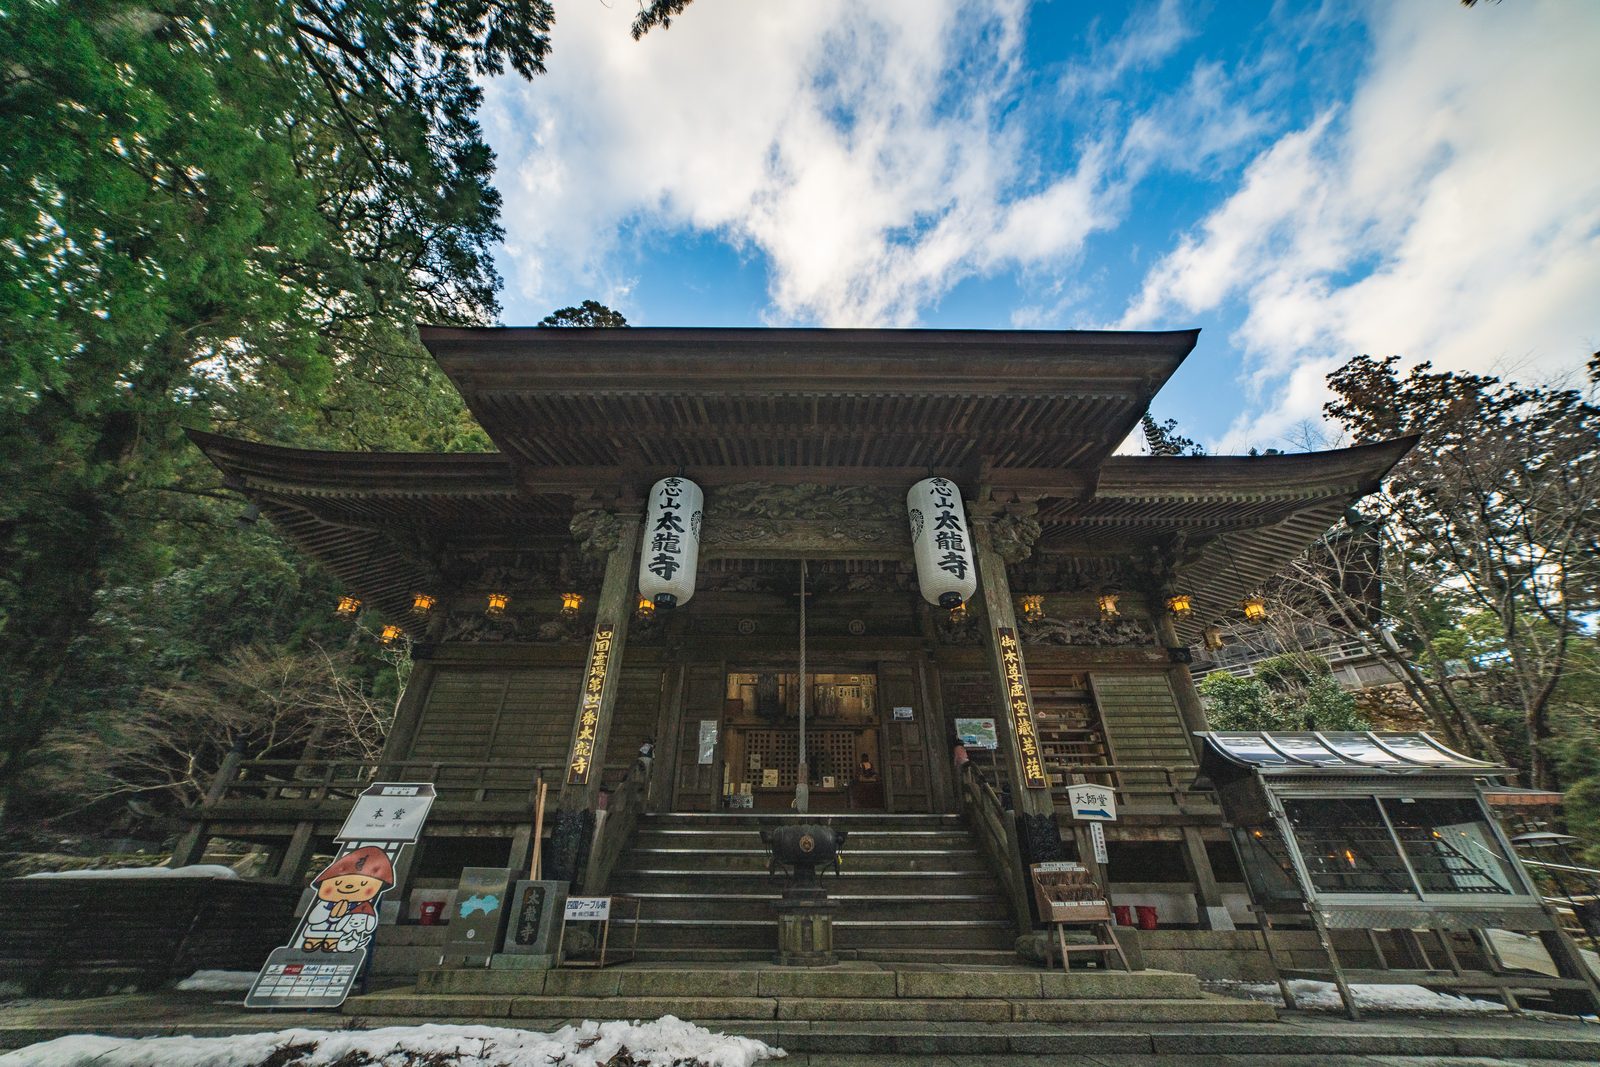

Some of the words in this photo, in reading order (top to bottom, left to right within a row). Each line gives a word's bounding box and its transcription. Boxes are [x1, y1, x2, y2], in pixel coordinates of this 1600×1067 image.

[1075, 792, 1108, 807] 大師堂
[371, 807, 406, 820] 本堂
[520, 889, 540, 942] 太龍寺
